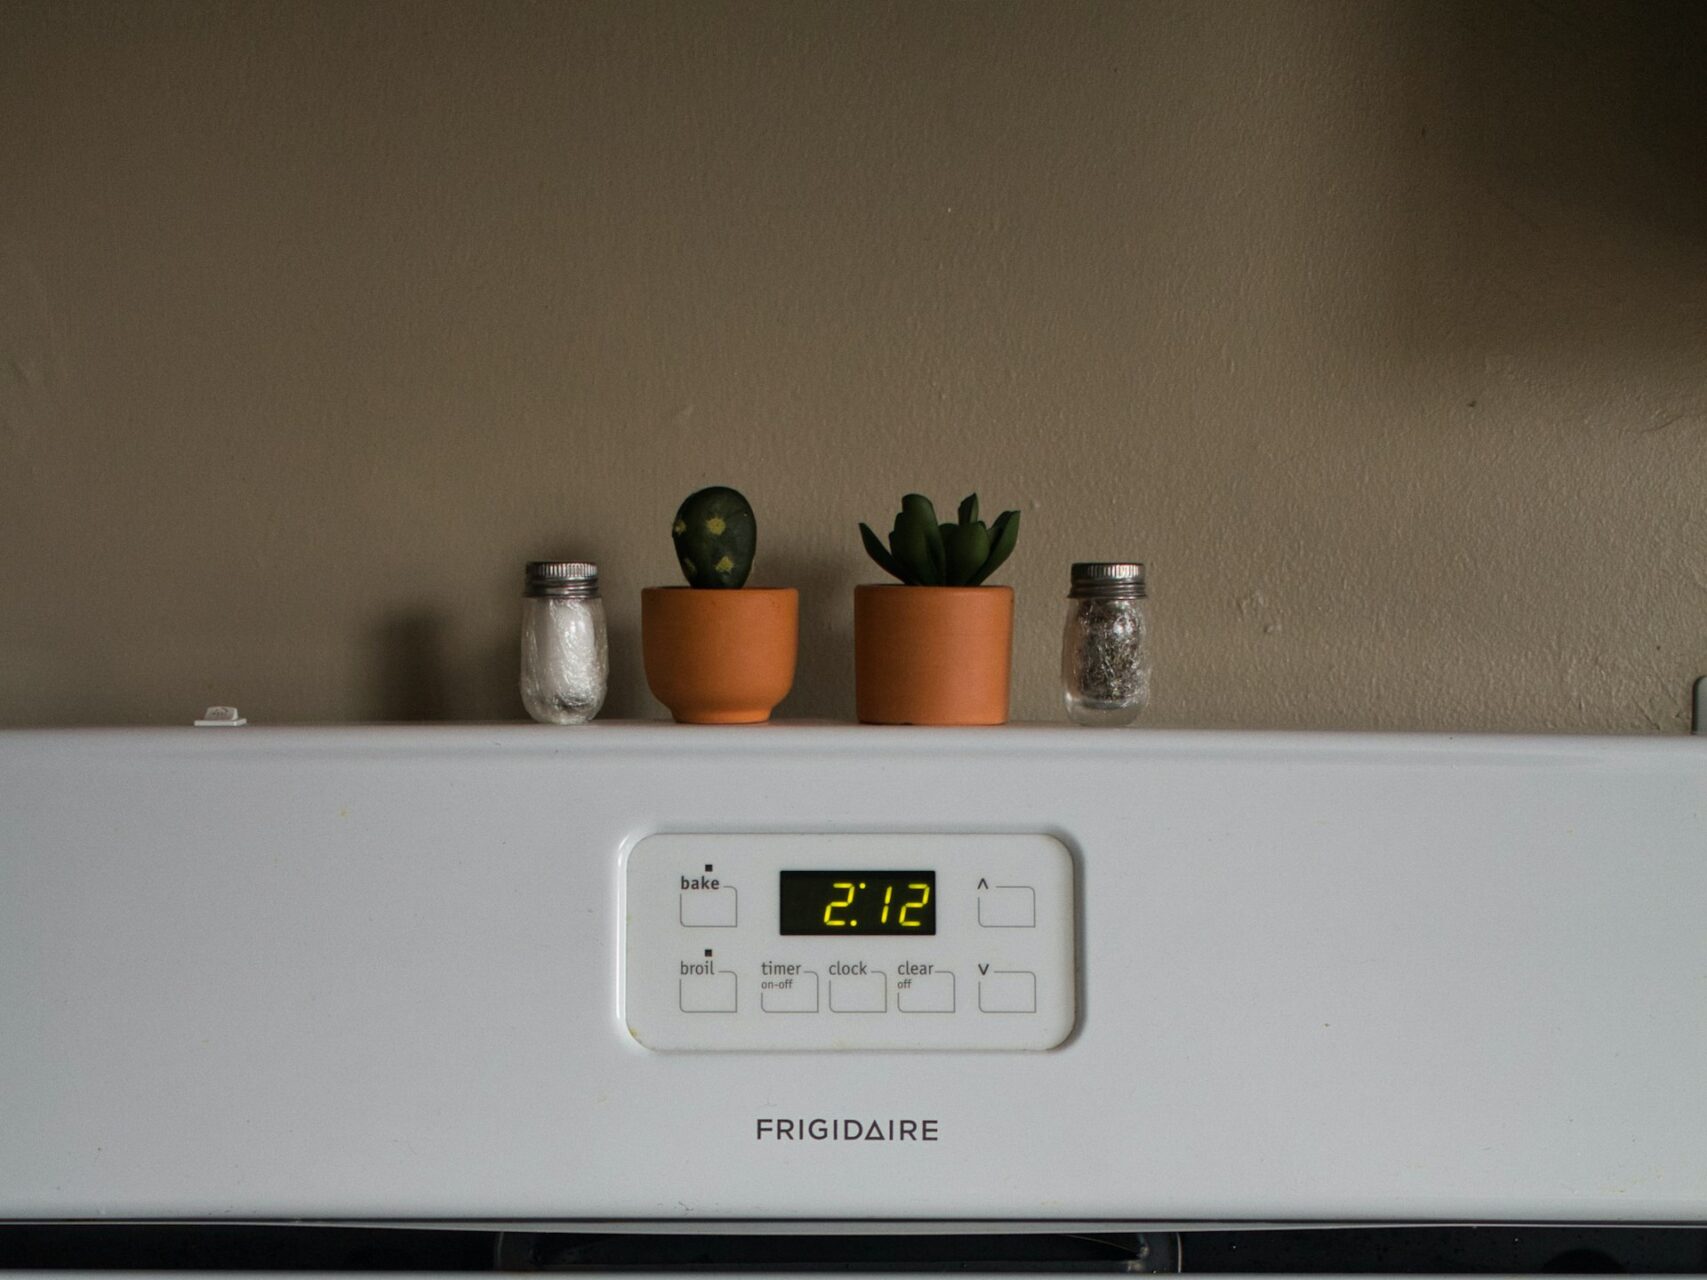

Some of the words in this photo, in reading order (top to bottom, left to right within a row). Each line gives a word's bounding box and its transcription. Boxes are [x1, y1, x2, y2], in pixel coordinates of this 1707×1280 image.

[680, 876, 720, 890] bake
[680, 961, 715, 976] broil
[761, 961, 802, 976] timer
[828, 961, 868, 976] clock
[897, 961, 934, 976] clear
[761, 979, 793, 990] on-off
[897, 979, 912, 990] off
[757, 1119, 938, 1140] FRIGIDAIRE
